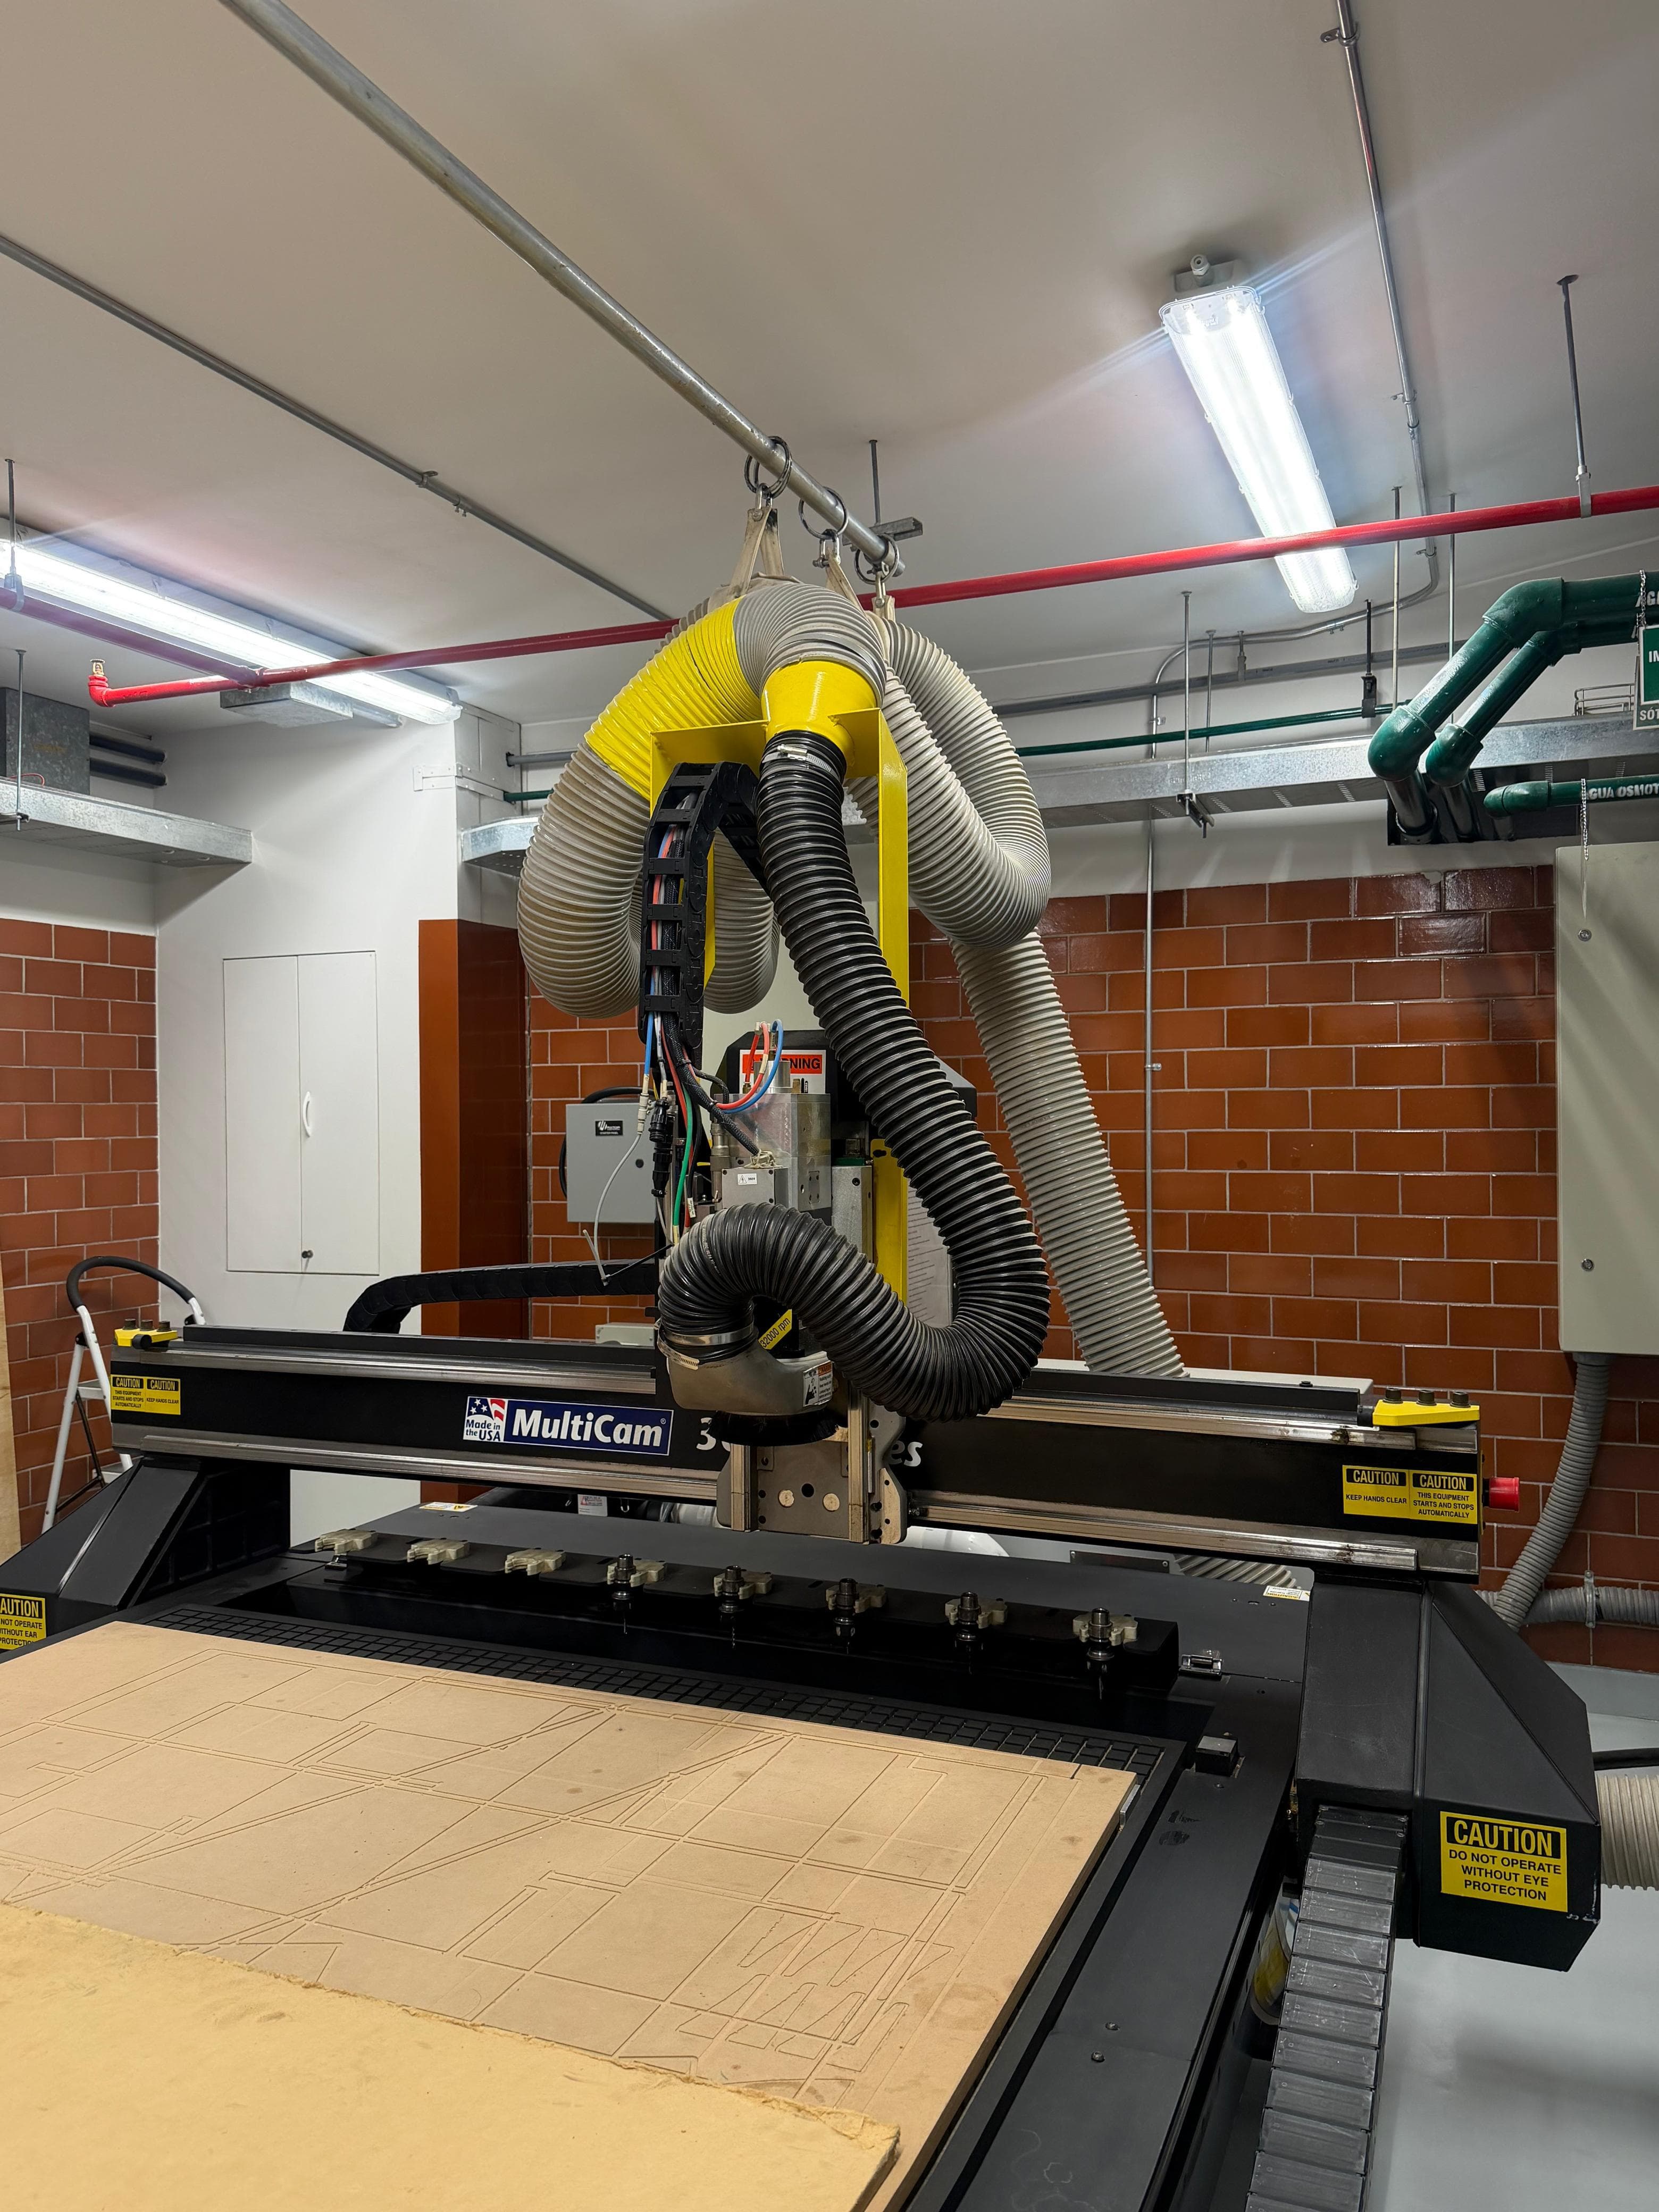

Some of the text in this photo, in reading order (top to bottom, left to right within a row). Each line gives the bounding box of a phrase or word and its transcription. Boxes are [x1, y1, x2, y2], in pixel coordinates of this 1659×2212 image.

[760, 1318, 791, 1347] 32000 rpm
[116, 1377, 140, 1388] CAUTION
[150, 1380, 175, 1390] CAUTION
[466, 1419, 491, 1429] Made
[512, 1409, 662, 1447] MultiCam
[479, 1430, 500, 1442] USA
[1353, 1470, 1399, 1485] CAUTION
[1420, 1474, 1467, 1490] CAUTION
[1418, 1509, 1469, 1518] AUTOMATICALLY
[14, 1620, 43, 1629] OPERATE
[1454, 1820, 1552, 1857] CAUTION
[1449, 1849, 1561, 1874] DO NOT OPERATE
[1461, 1865, 1549, 1887] WITHOUT EYE
[1464, 1879, 1547, 1901] PROTECTION
